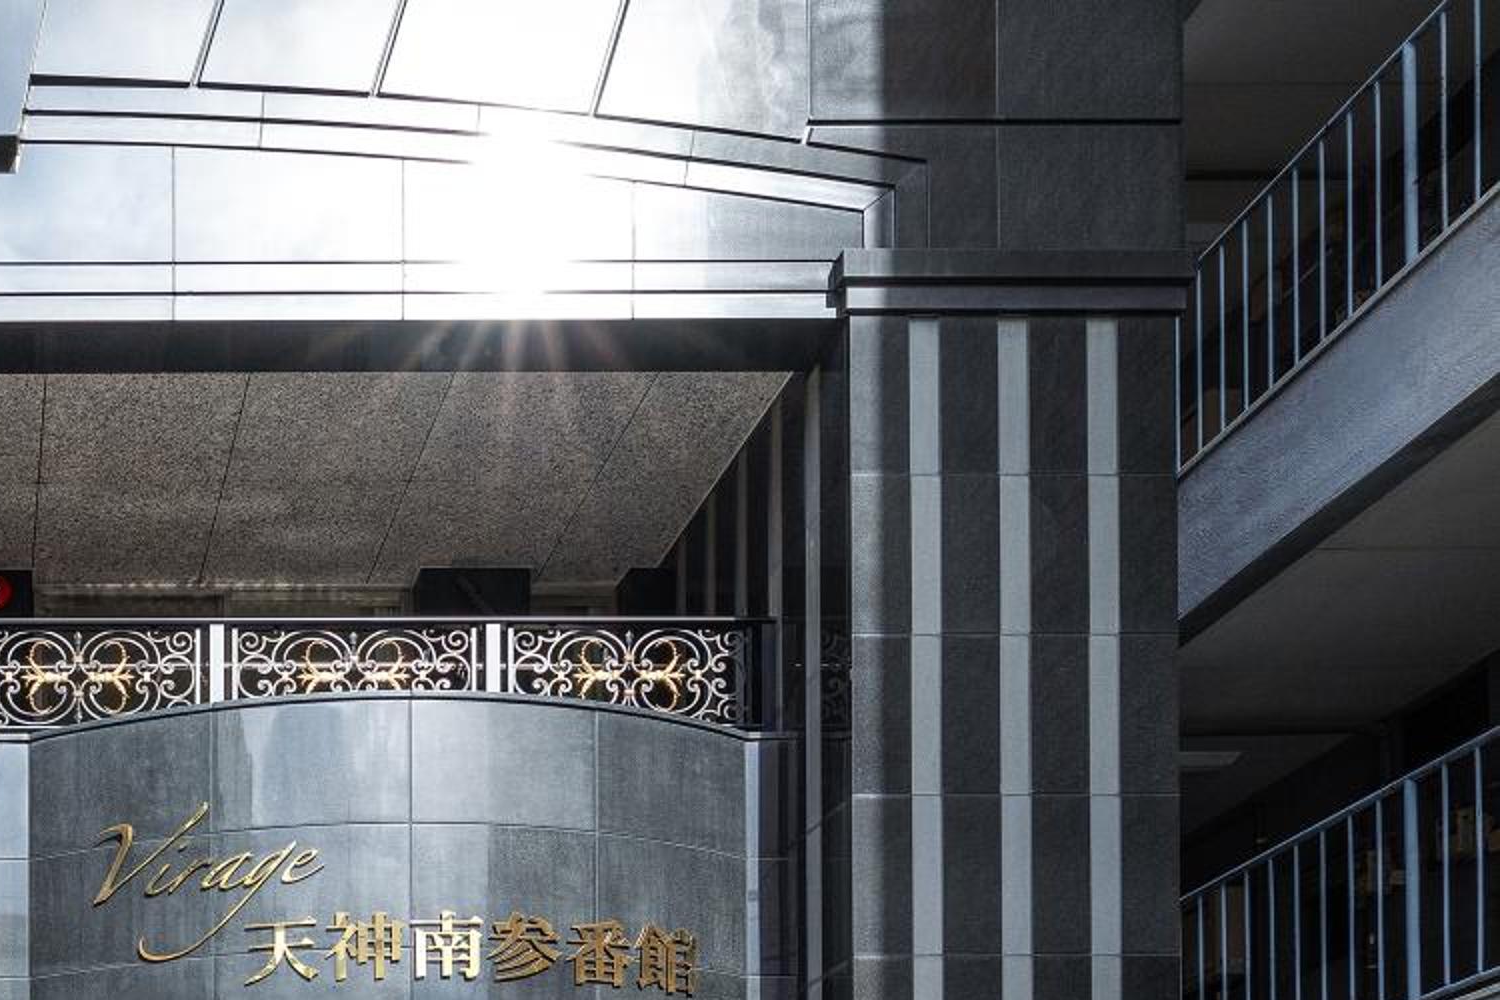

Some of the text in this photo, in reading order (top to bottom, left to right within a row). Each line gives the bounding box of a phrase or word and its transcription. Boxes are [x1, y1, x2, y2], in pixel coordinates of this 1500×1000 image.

[93, 802, 325, 963] Virage
[244, 909, 697, 998] 天神南参番館
